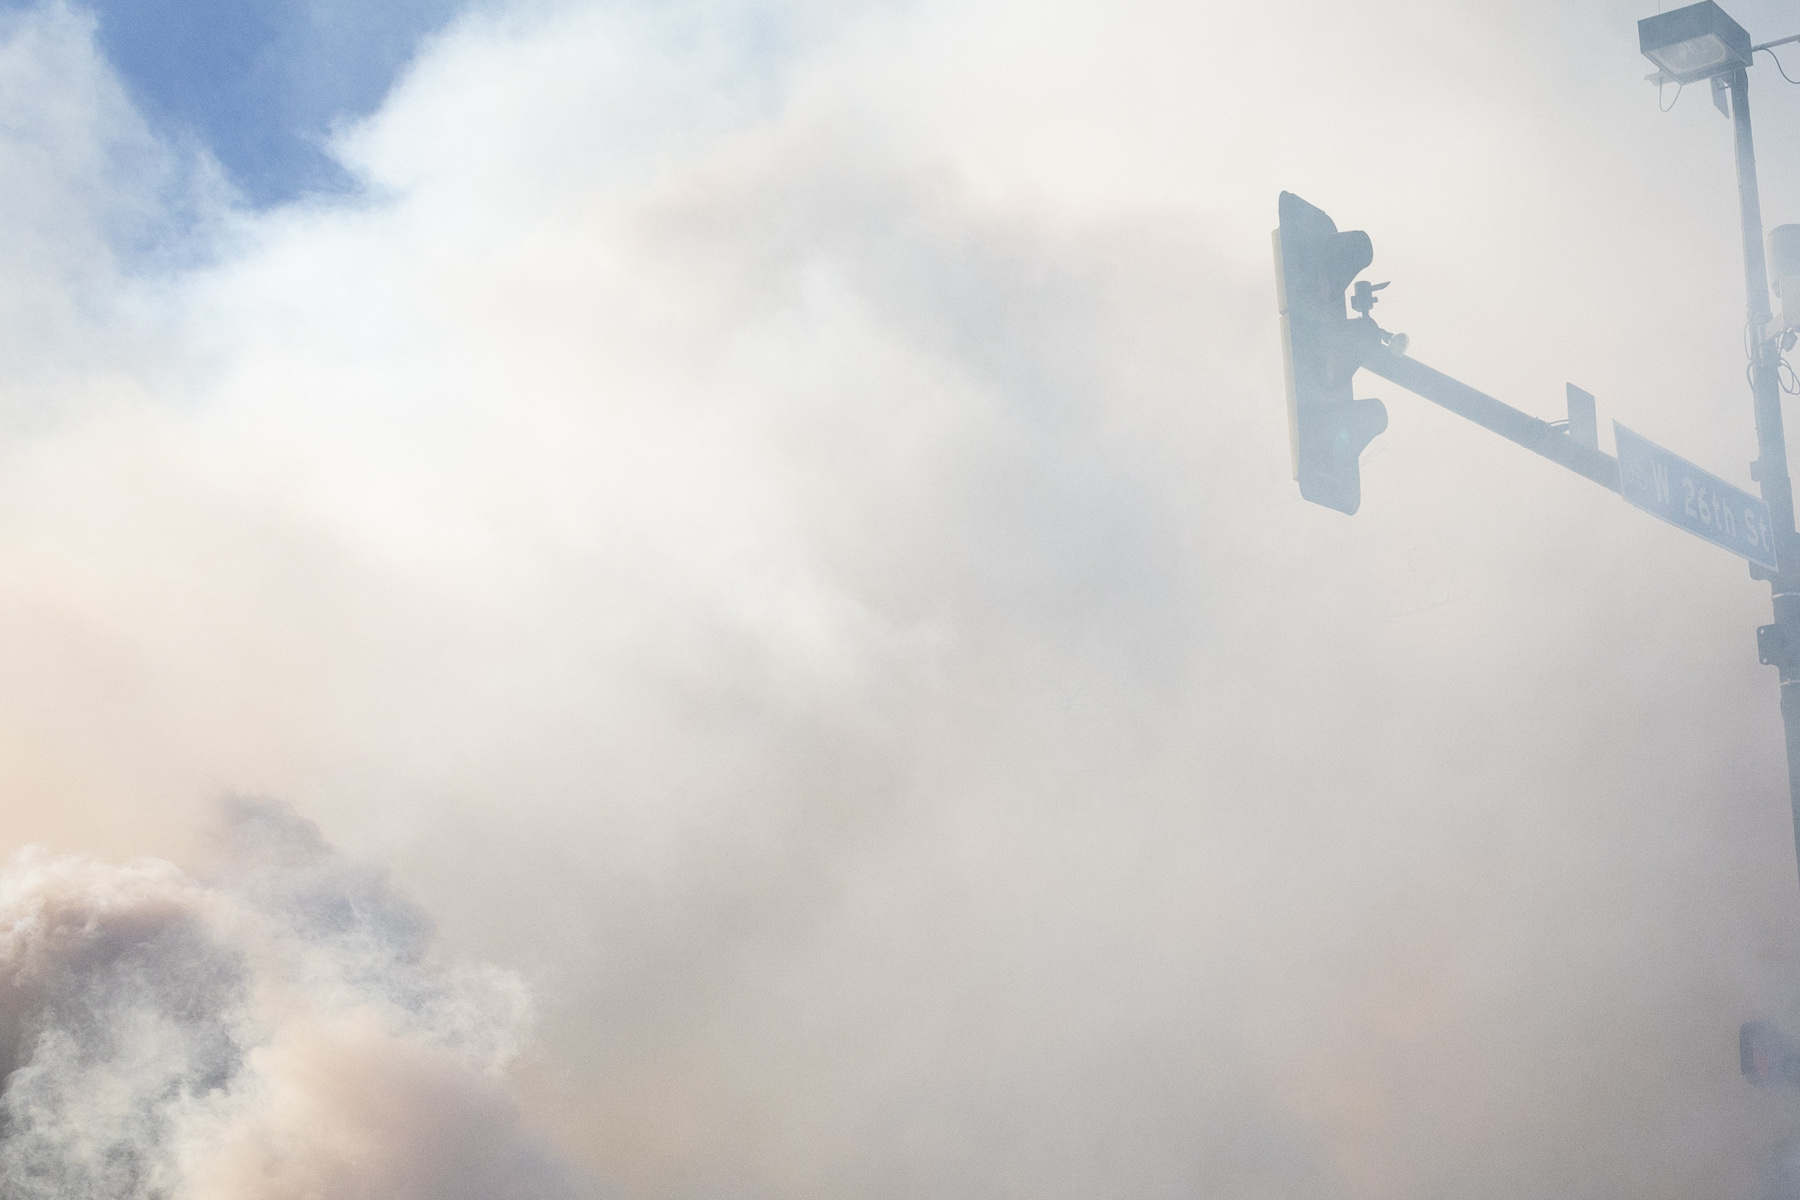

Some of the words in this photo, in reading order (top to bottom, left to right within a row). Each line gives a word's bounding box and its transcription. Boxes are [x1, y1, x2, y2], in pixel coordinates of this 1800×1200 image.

[1651, 460, 1670, 505] W
[1682, 477, 1738, 539] 26th
[1744, 508, 1770, 554] St
